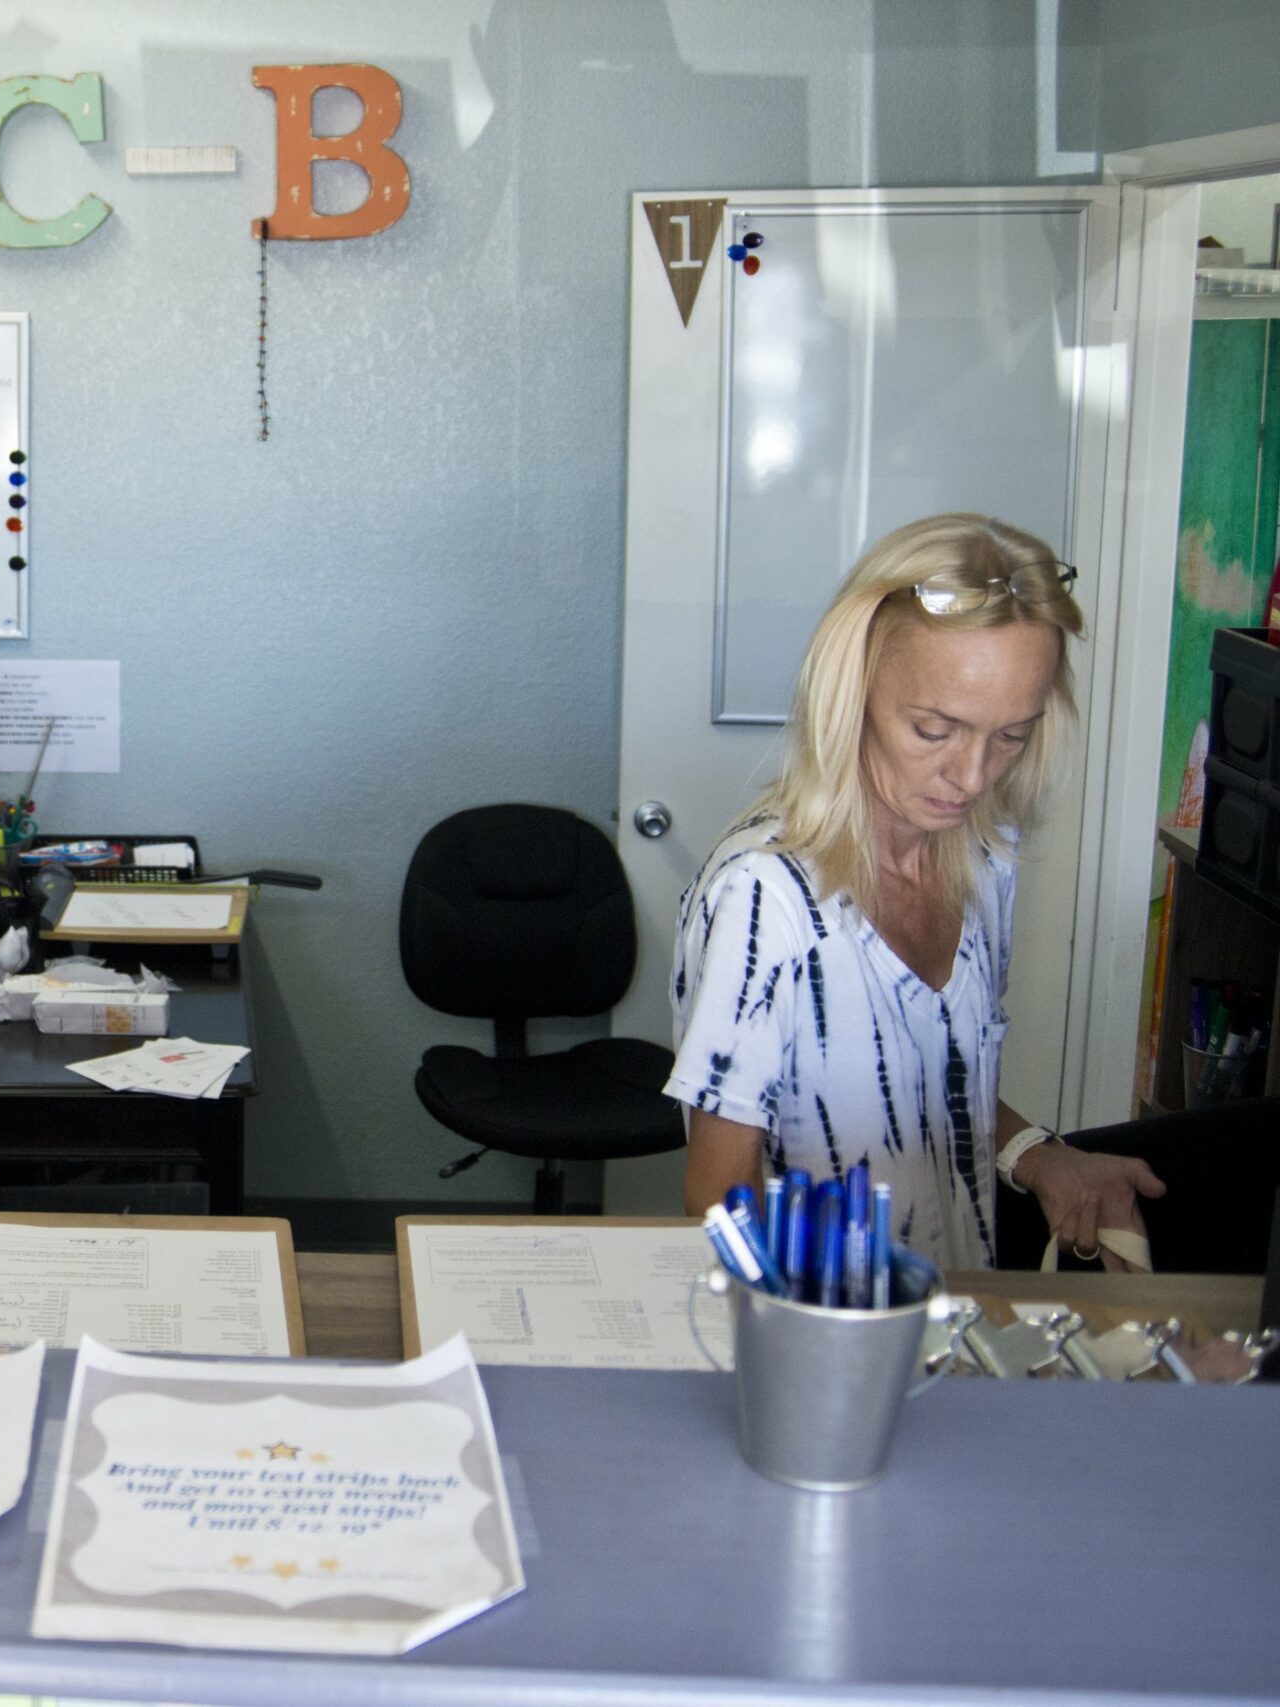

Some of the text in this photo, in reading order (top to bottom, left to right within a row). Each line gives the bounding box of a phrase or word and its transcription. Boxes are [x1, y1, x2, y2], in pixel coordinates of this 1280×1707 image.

[668, 215, 704, 270] 1
[108, 1463, 461, 1489] Bring your test strips back
[116, 1481, 174, 1495] And
[177, 1484, 217, 1497] get
[263, 1486, 335, 1499] extra
[343, 1488, 444, 1503] needles
[141, 1499, 197, 1512] and
[203, 1502, 275, 1515] more
[281, 1503, 330, 1516] test
